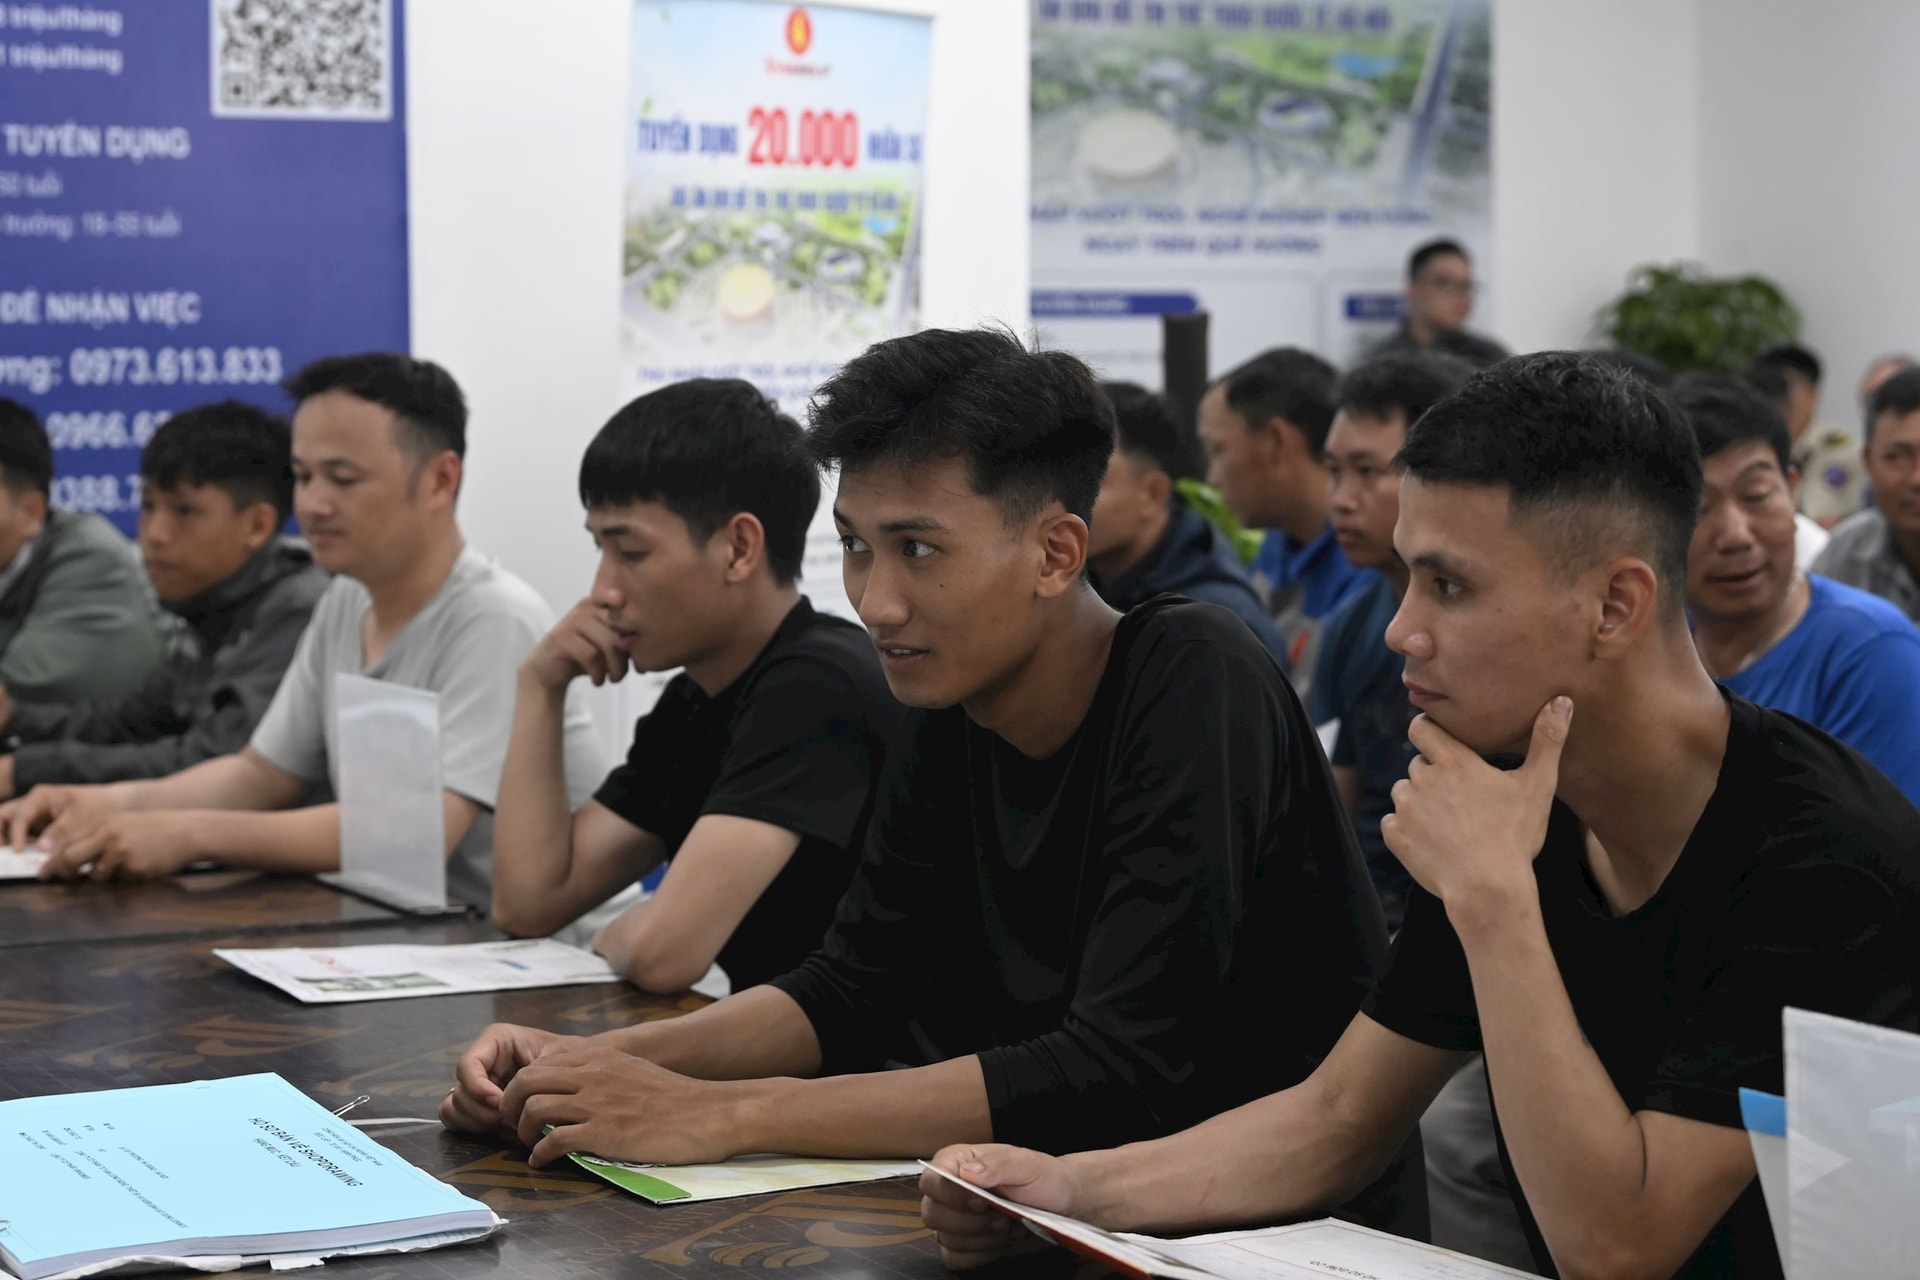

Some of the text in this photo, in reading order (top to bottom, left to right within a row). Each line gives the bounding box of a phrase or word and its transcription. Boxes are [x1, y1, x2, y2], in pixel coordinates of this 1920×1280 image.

[4, 119, 190, 164] TUYỂN DỤNG
[747, 105, 859, 169] 20.000
[45, 289, 130, 329] NHẬN
[133, 288, 201, 330] VIỆC
[69, 346, 283, 386] 0973.613.833
